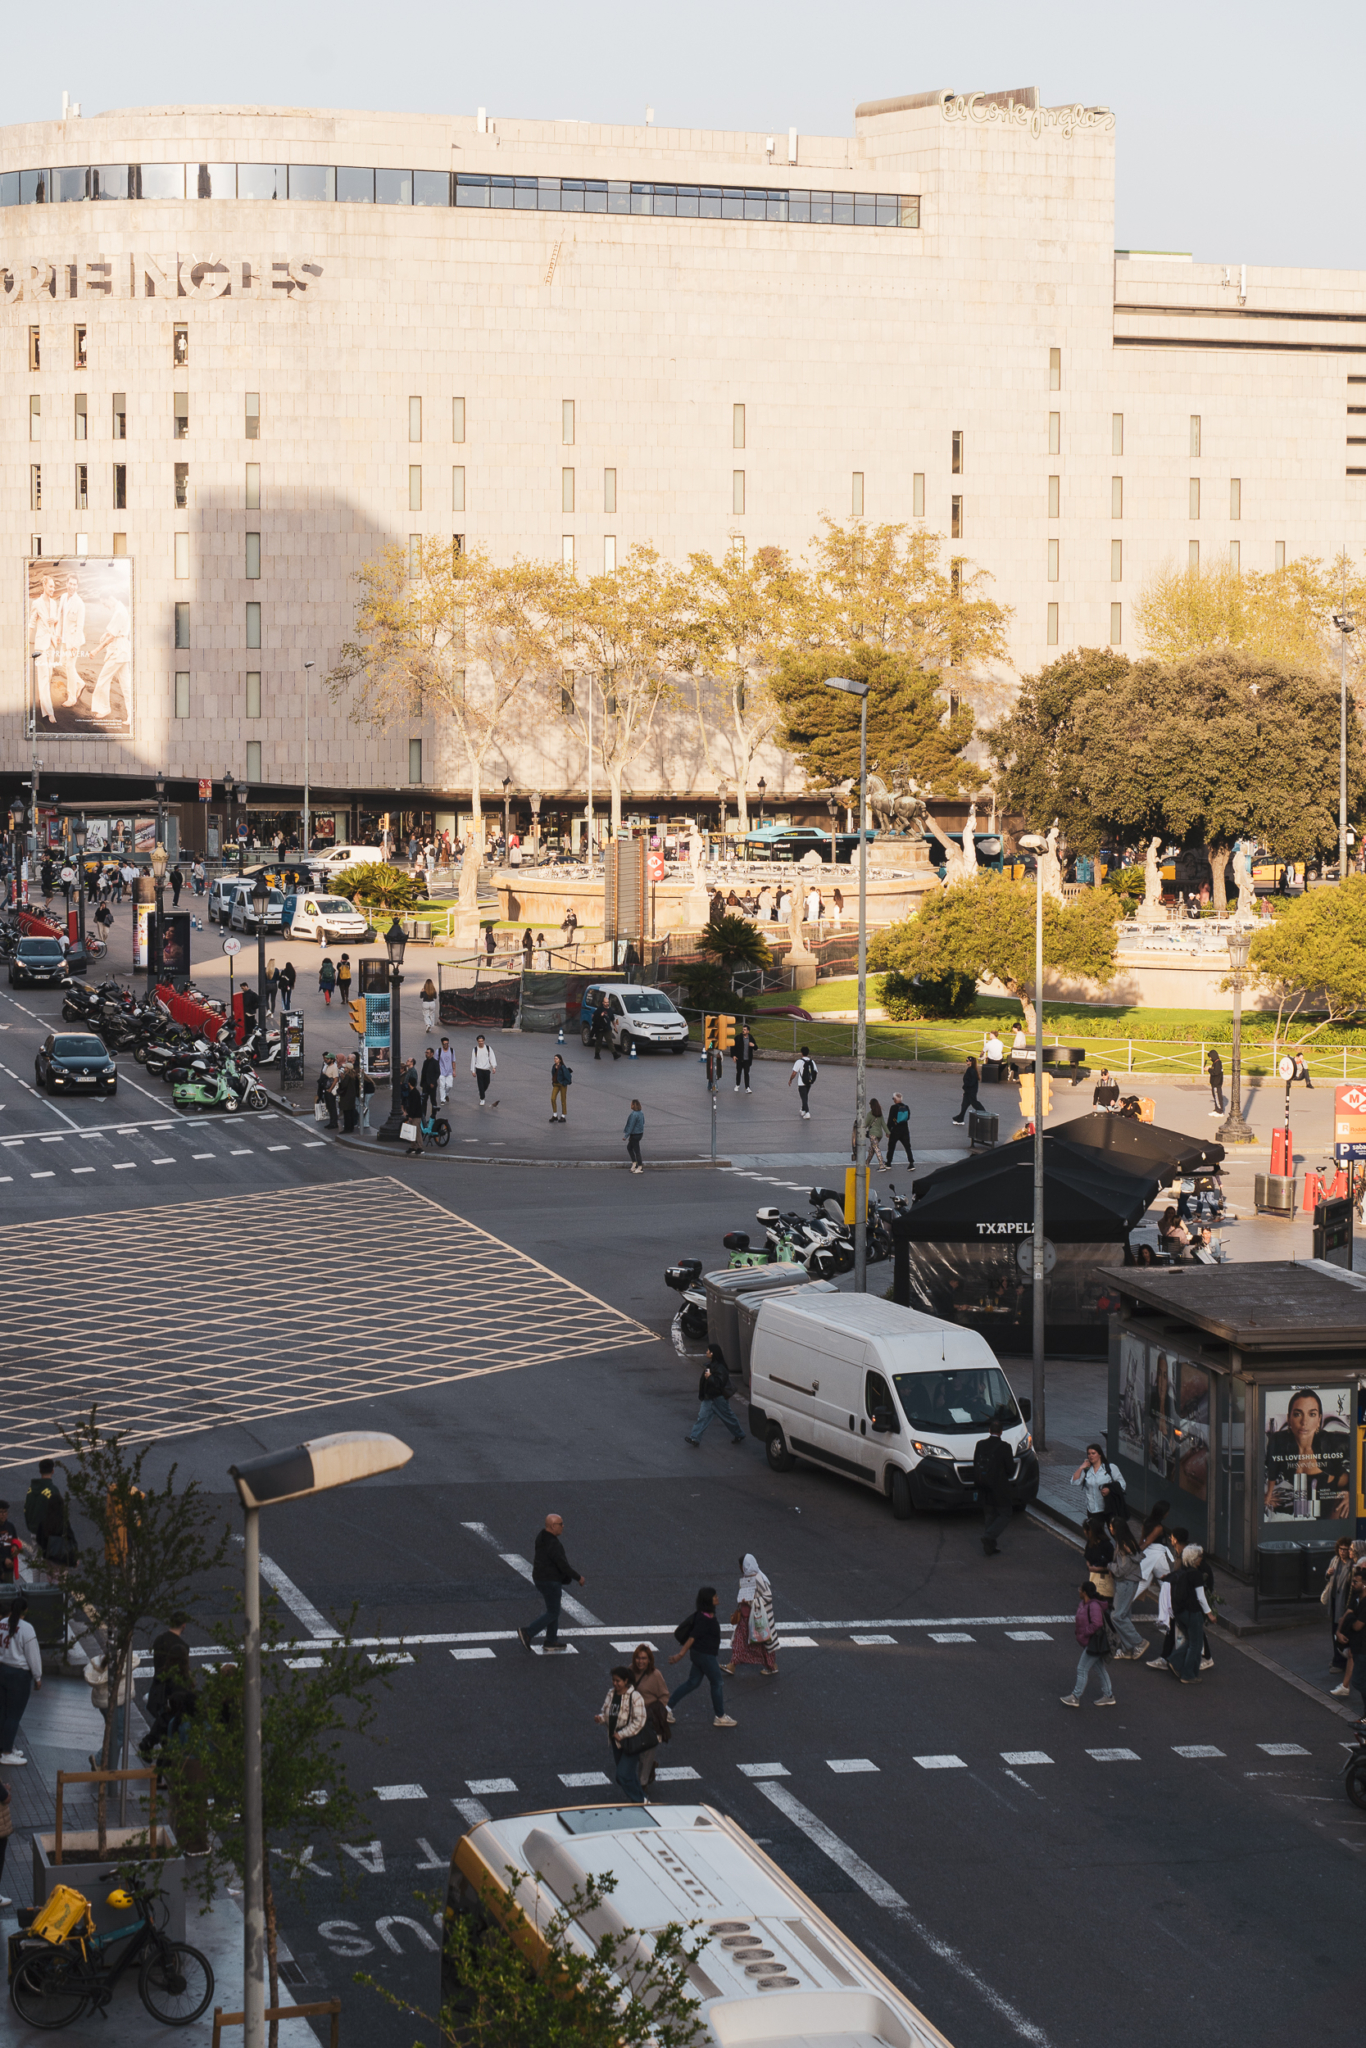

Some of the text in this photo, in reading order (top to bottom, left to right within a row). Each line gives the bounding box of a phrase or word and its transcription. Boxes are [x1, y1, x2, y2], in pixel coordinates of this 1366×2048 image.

[968, 91, 1027, 125] Corte
[120, 251, 321, 303] INGLES
[1349, 1094, 1360, 1103] M
[1340, 1143, 1350, 1156] P
[1285, 1453, 1321, 1461] LOVESHINE
[270, 1837, 450, 1879] TAX
[318, 1912, 444, 1957] US
